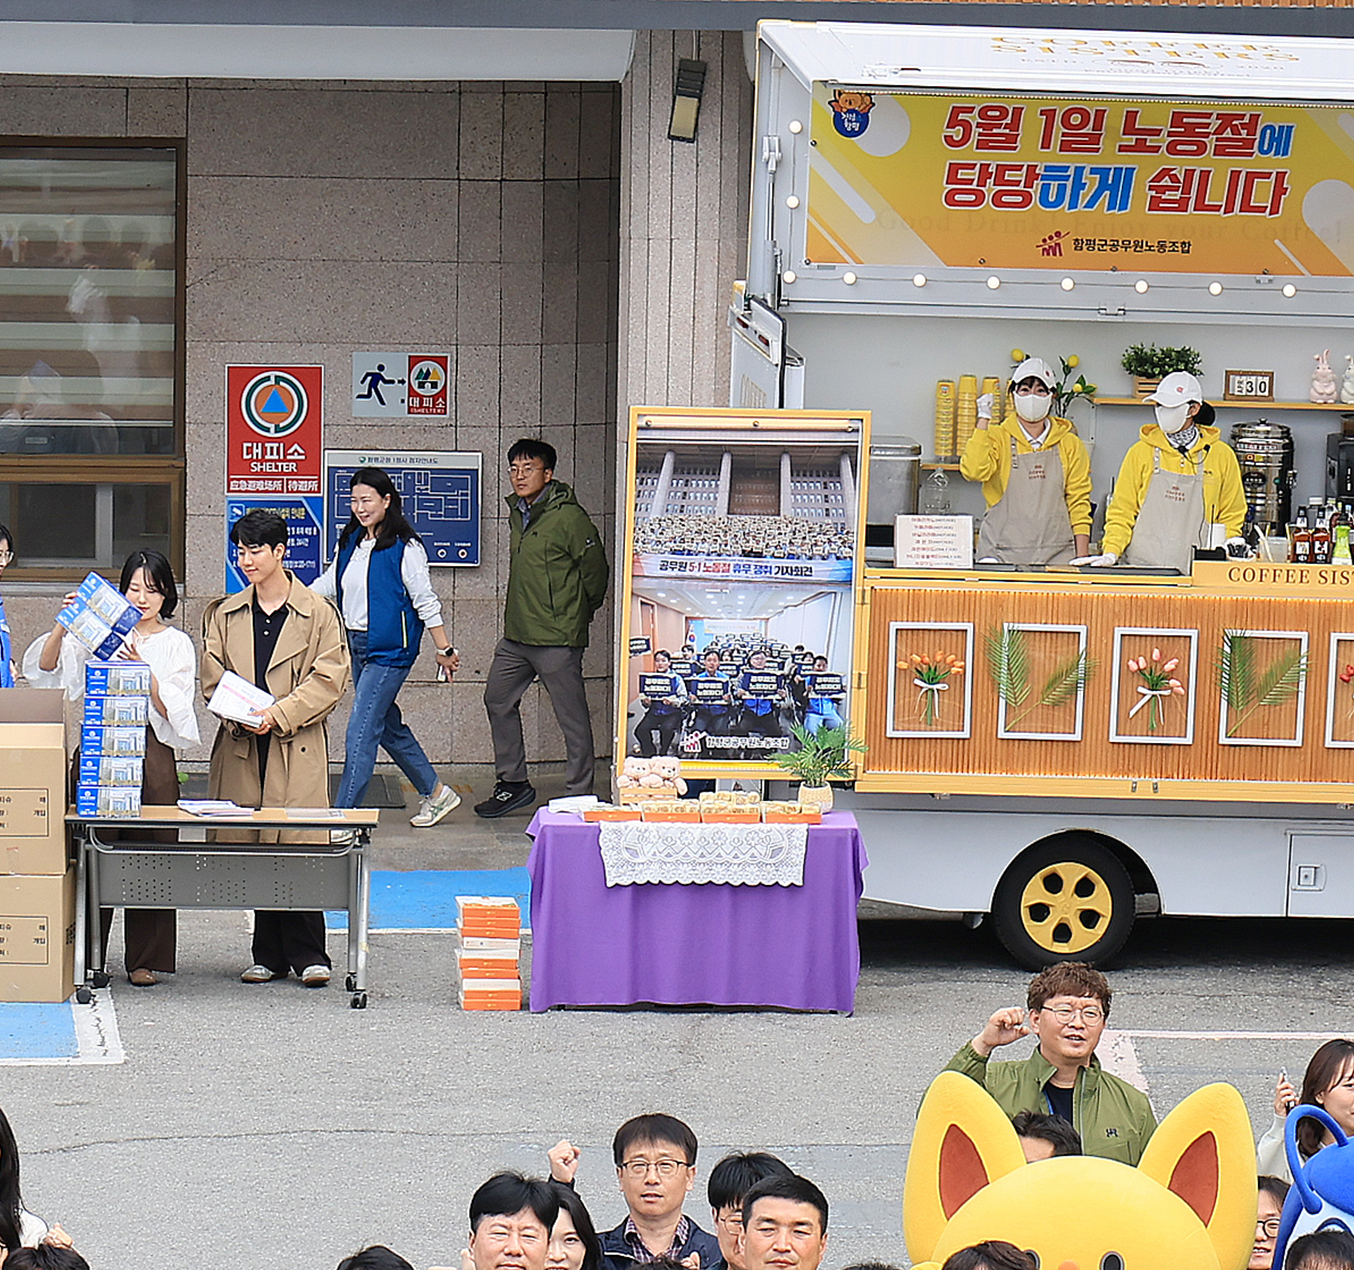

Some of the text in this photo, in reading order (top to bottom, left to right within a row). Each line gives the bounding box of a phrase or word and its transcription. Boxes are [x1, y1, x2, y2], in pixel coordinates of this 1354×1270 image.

[942, 104, 1295, 158] 5월 1일 노동절에
[944, 160, 1290, 218] 당당하게 쉽니다
[1072, 237, 1192, 255] 함평군공무원노동조합
[243, 442, 306, 460] 대피소
[250, 462, 298, 473] SHELTER
[659, 559, 687, 572] 공무원
[1228, 566, 1310, 584] COFFEE
